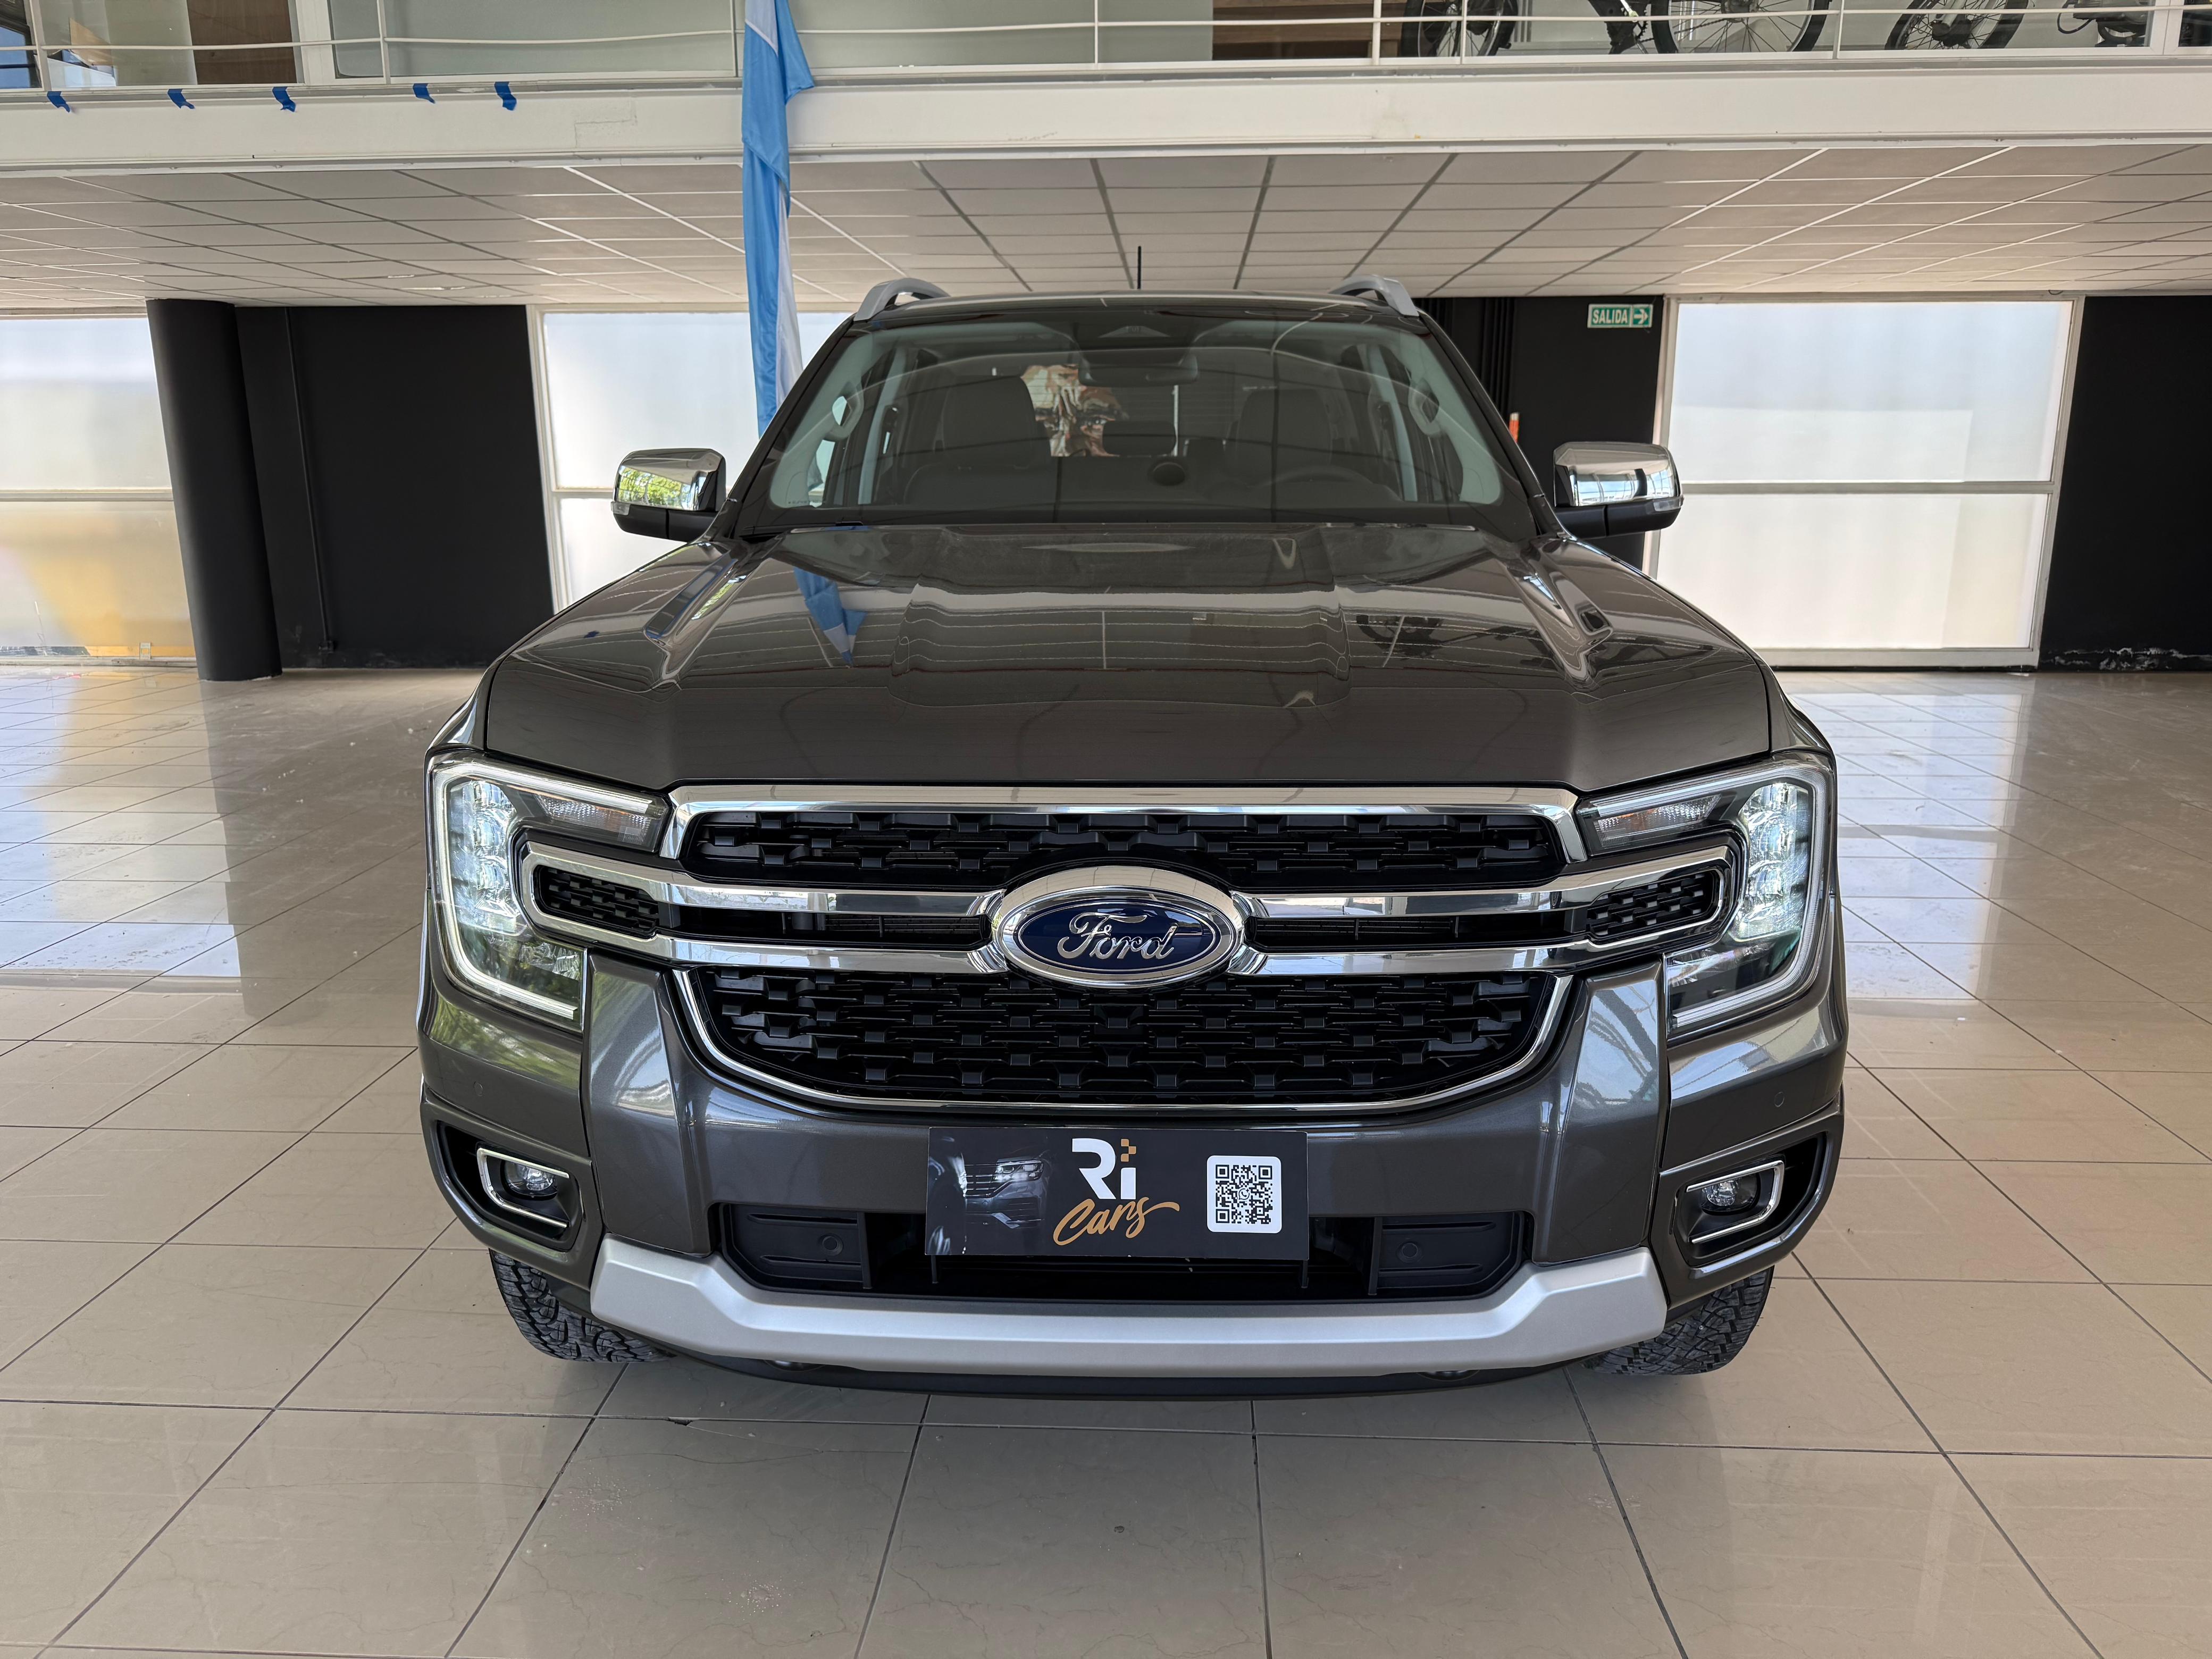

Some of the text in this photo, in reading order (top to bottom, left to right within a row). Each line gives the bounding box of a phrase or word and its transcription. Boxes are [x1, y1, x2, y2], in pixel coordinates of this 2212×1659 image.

[1593, 309, 1628, 324] SALIDA
[1058, 912, 1177, 959] Ford
[1053, 1197, 1180, 1245] Cars
